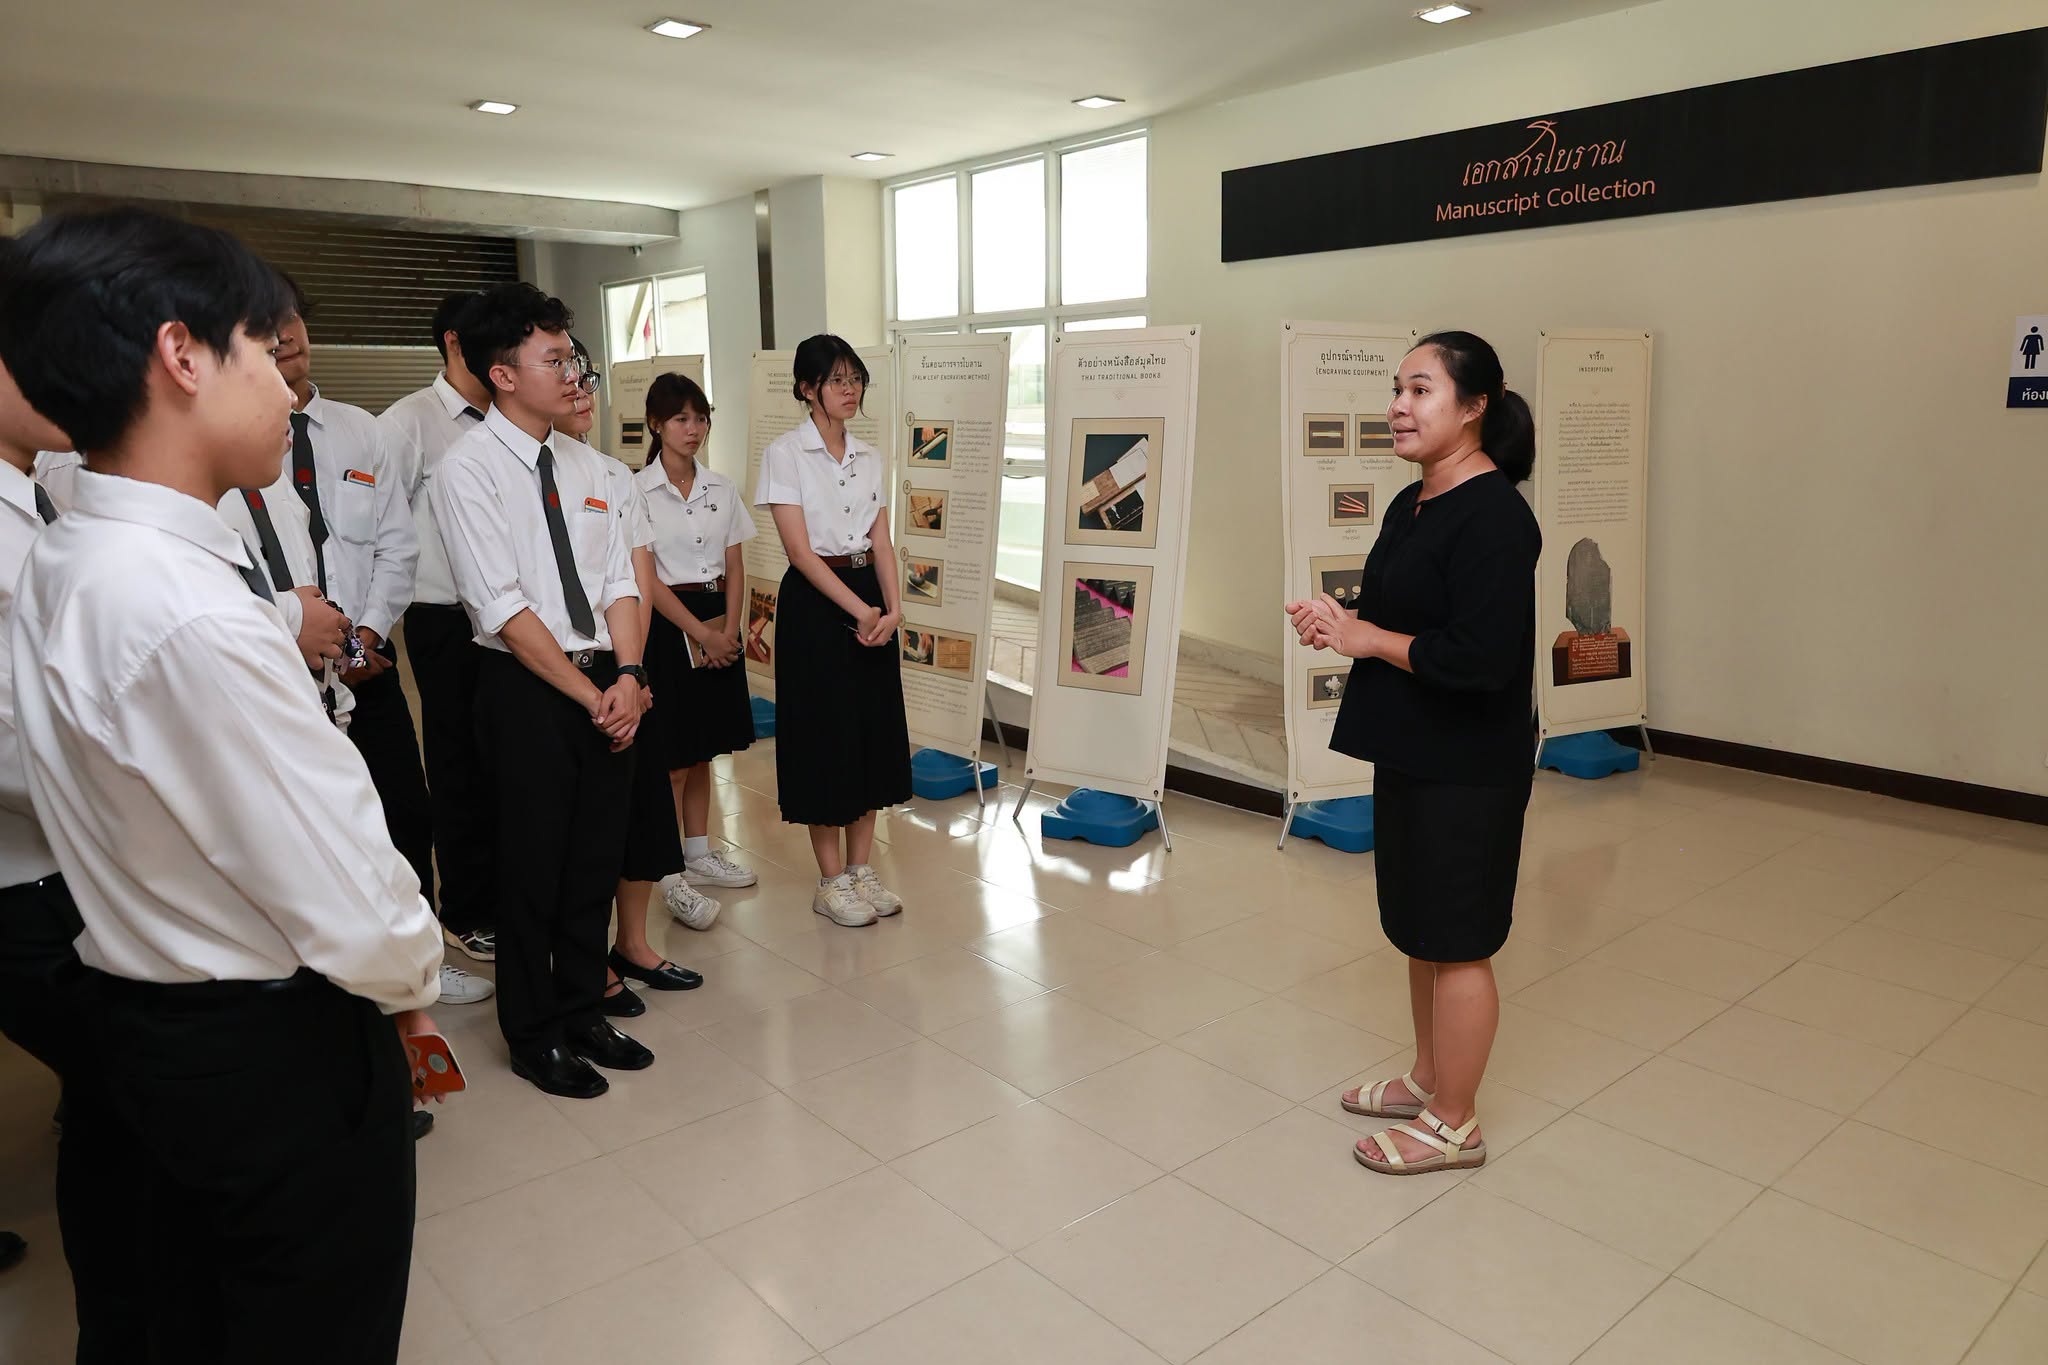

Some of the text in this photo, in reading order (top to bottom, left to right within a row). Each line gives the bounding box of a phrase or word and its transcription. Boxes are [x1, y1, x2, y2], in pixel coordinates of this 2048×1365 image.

[1462, 119, 1627, 186] เอกสารโบราณ
[1435, 178, 1656, 222] Manuscript Collection
[1097, 373, 1138, 381] TRADITIONAL
[1139, 372, 1161, 380] BOOKS
